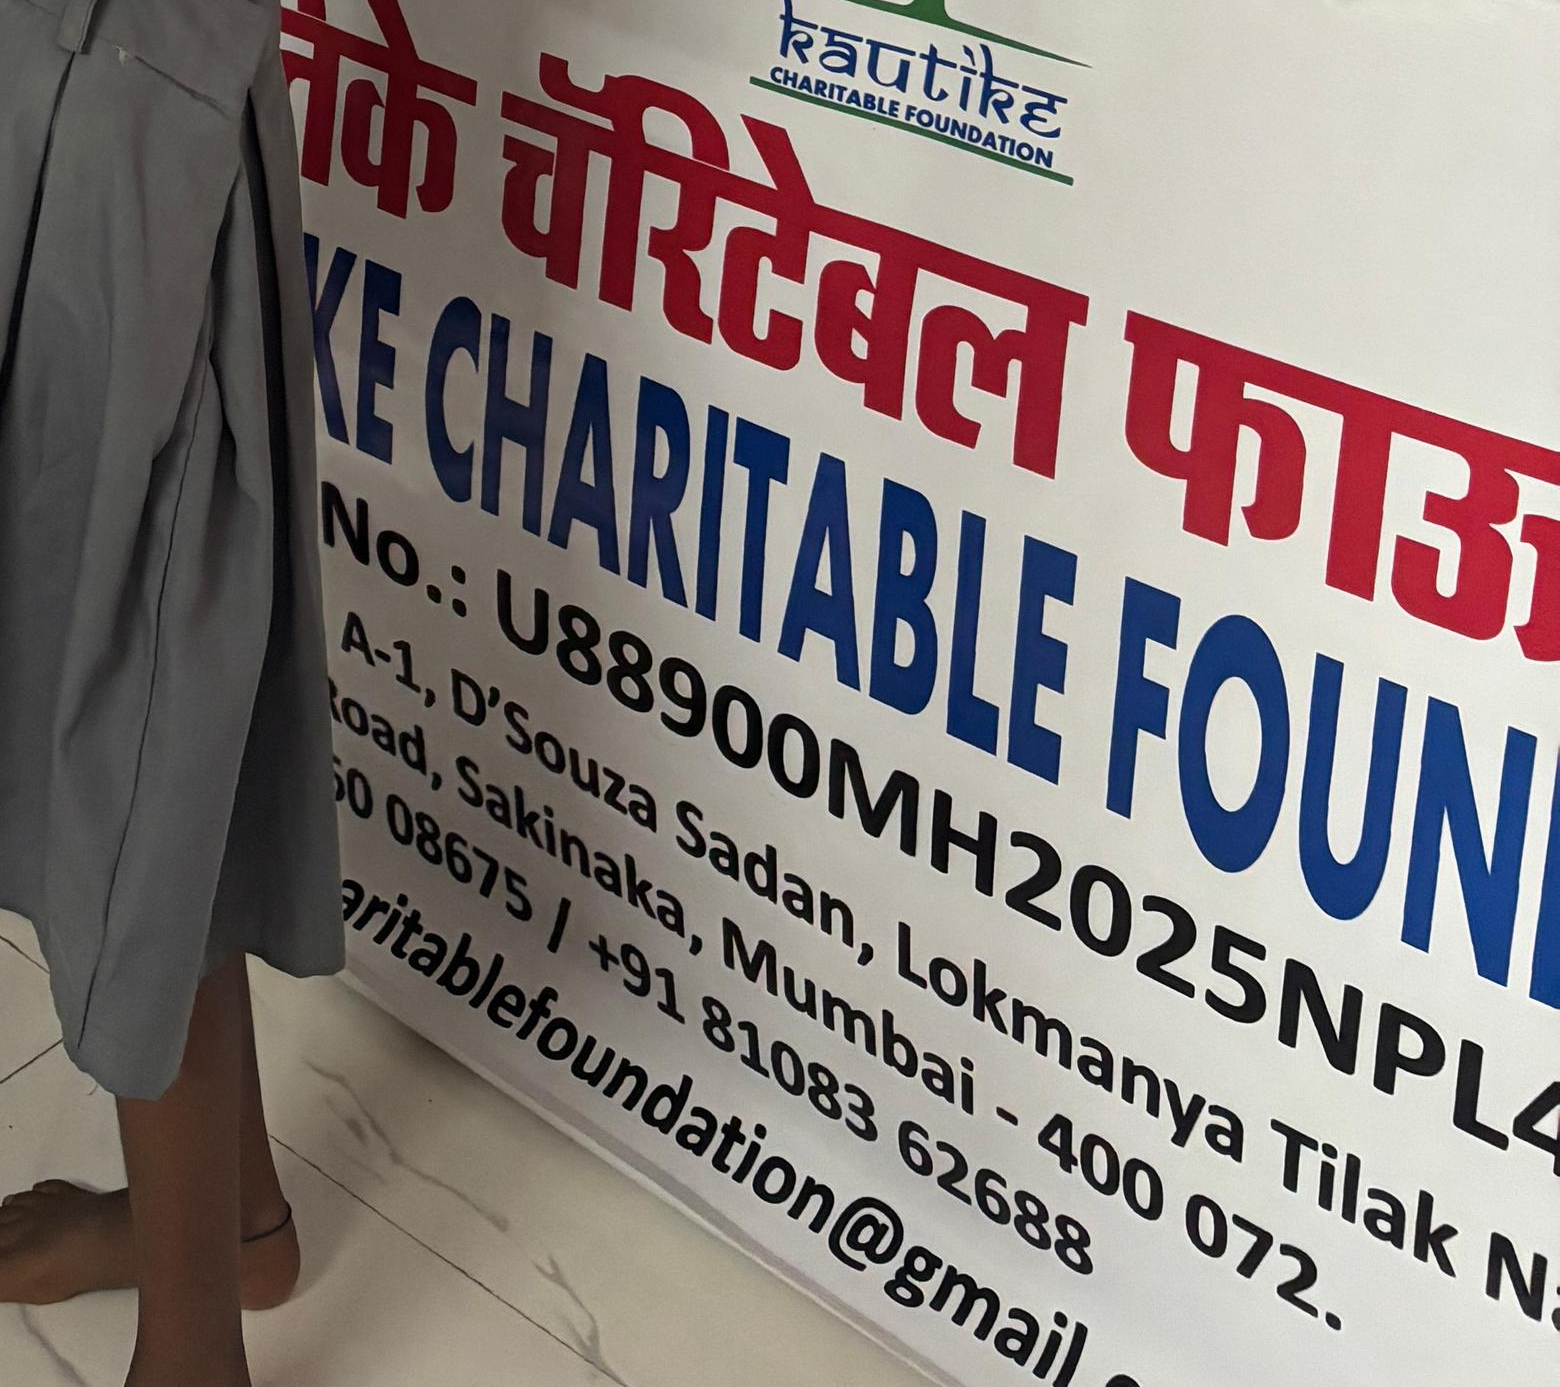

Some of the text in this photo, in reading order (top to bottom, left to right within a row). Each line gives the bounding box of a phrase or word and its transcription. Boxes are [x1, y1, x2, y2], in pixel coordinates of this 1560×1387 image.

[769, 66, 1054, 168] CHARITABLE FOUNDATION
[321, 481, 468, 618] No.:
[425, 295, 1079, 785] CHARITABLE
[1106, 576, 1560, 1010] FOUN
[341, 611, 437, 708] A-1,
[675, 802, 877, 967] Sadan,
[897, 921, 1245, 1163] Lokmanya
[1269, 1118, 1459, 1278] Tilak
[386, 792, 535, 924] 08675
[587, 933, 686, 1024] +91
[701, 992, 880, 1143] 81083
[896, 1116, 1095, 1277] 62688
[456, 755, 705, 955] Sakinaka,
[722, 919, 978, 1116] Mumbai
[1037, 1111, 1165, 1224] 400
[1184, 1193, 1345, 1332] 072.
